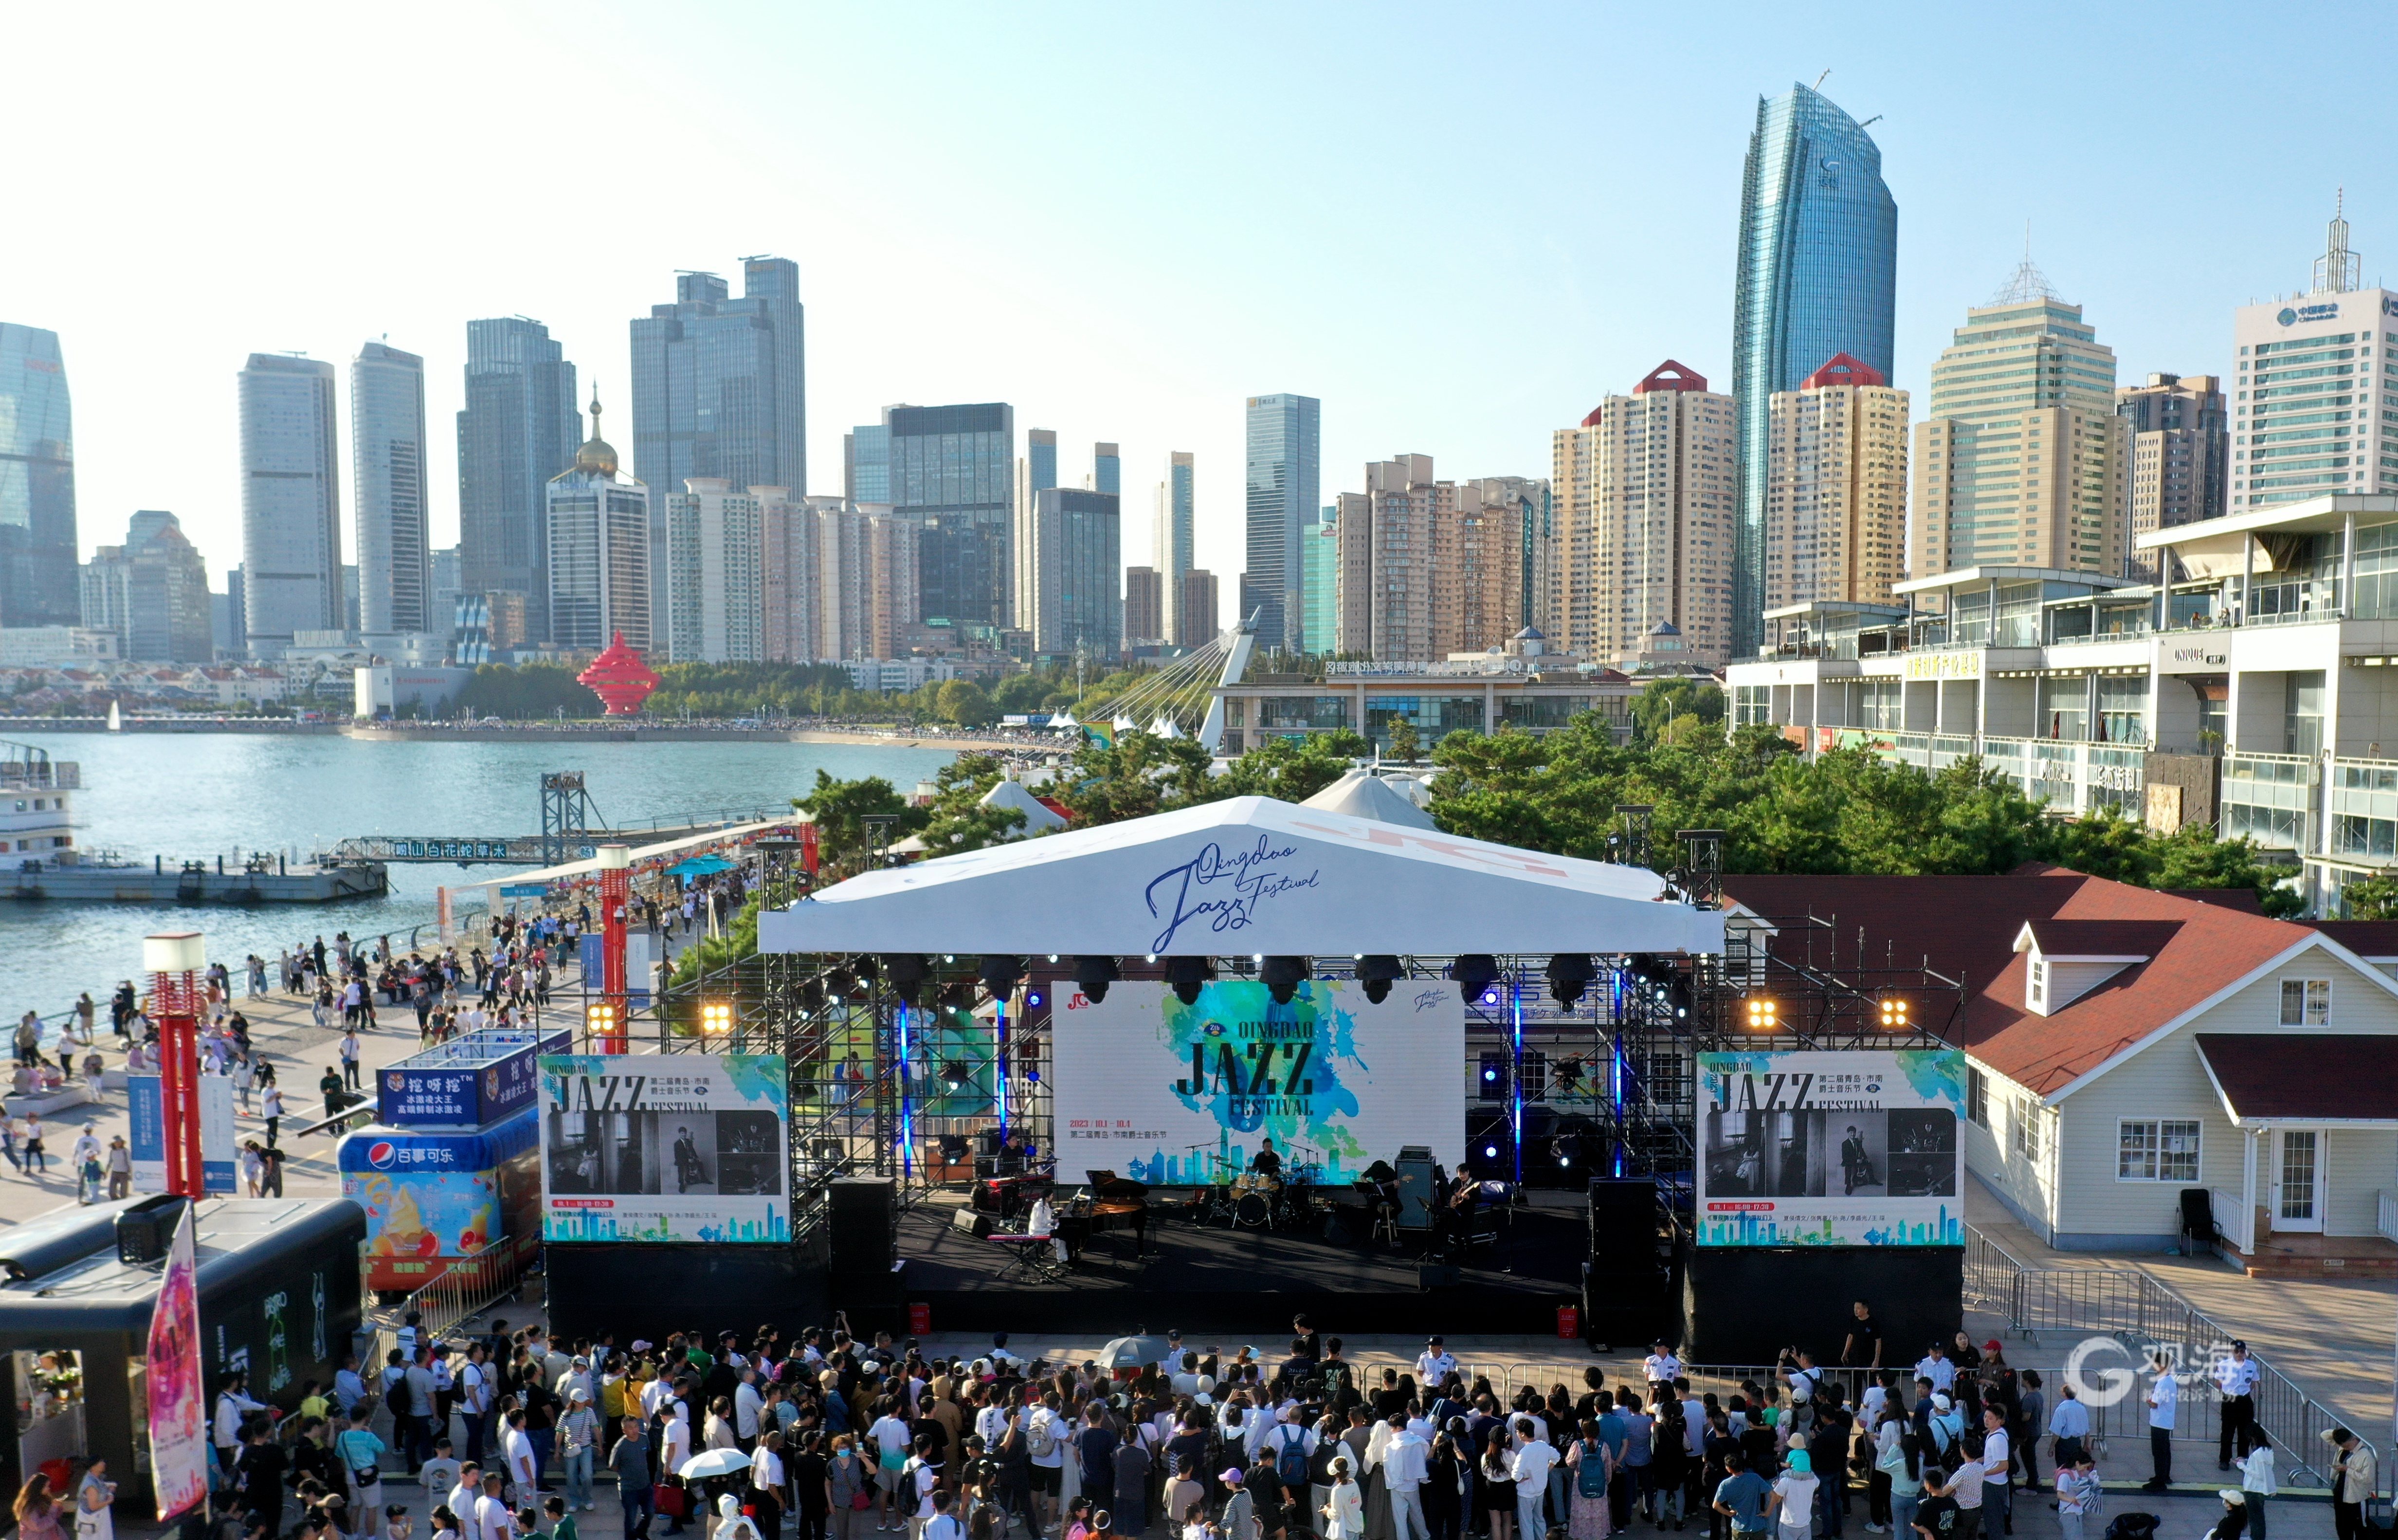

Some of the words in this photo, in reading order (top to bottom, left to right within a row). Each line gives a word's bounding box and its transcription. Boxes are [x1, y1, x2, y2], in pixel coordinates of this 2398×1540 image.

[2298, 303, 2338, 315] 中国移动
[2174, 648, 2203, 662] UNIQUE
[1196, 834, 1297, 885] Qingdao
[1145, 859, 1252, 954] Jazz
[1236, 870, 1319, 916] Festival
[1239, 1021, 1313, 1039] QINGDAO
[1177, 1042, 1313, 1095] JAZZ
[408, 1077, 460, 1093] 挖呀挖
[1818, 1074, 1883, 1083] 第二届青岛·市南
[550, 1076, 646, 1114] JAZZ
[1710, 1073, 1815, 1114] JAZZ
[1818, 1085, 1861, 1093] 爵士音乐节
[651, 1102, 711, 1115] FESTIVAL
[1230, 1099, 1314, 1116] FESTIVAL
[1819, 1100, 1883, 1114] FESTIVAL
[1071, 1130, 1167, 1139] 第二届青岛·市南爵士音乐节
[398, 1148, 454, 1163] 百事可乐
